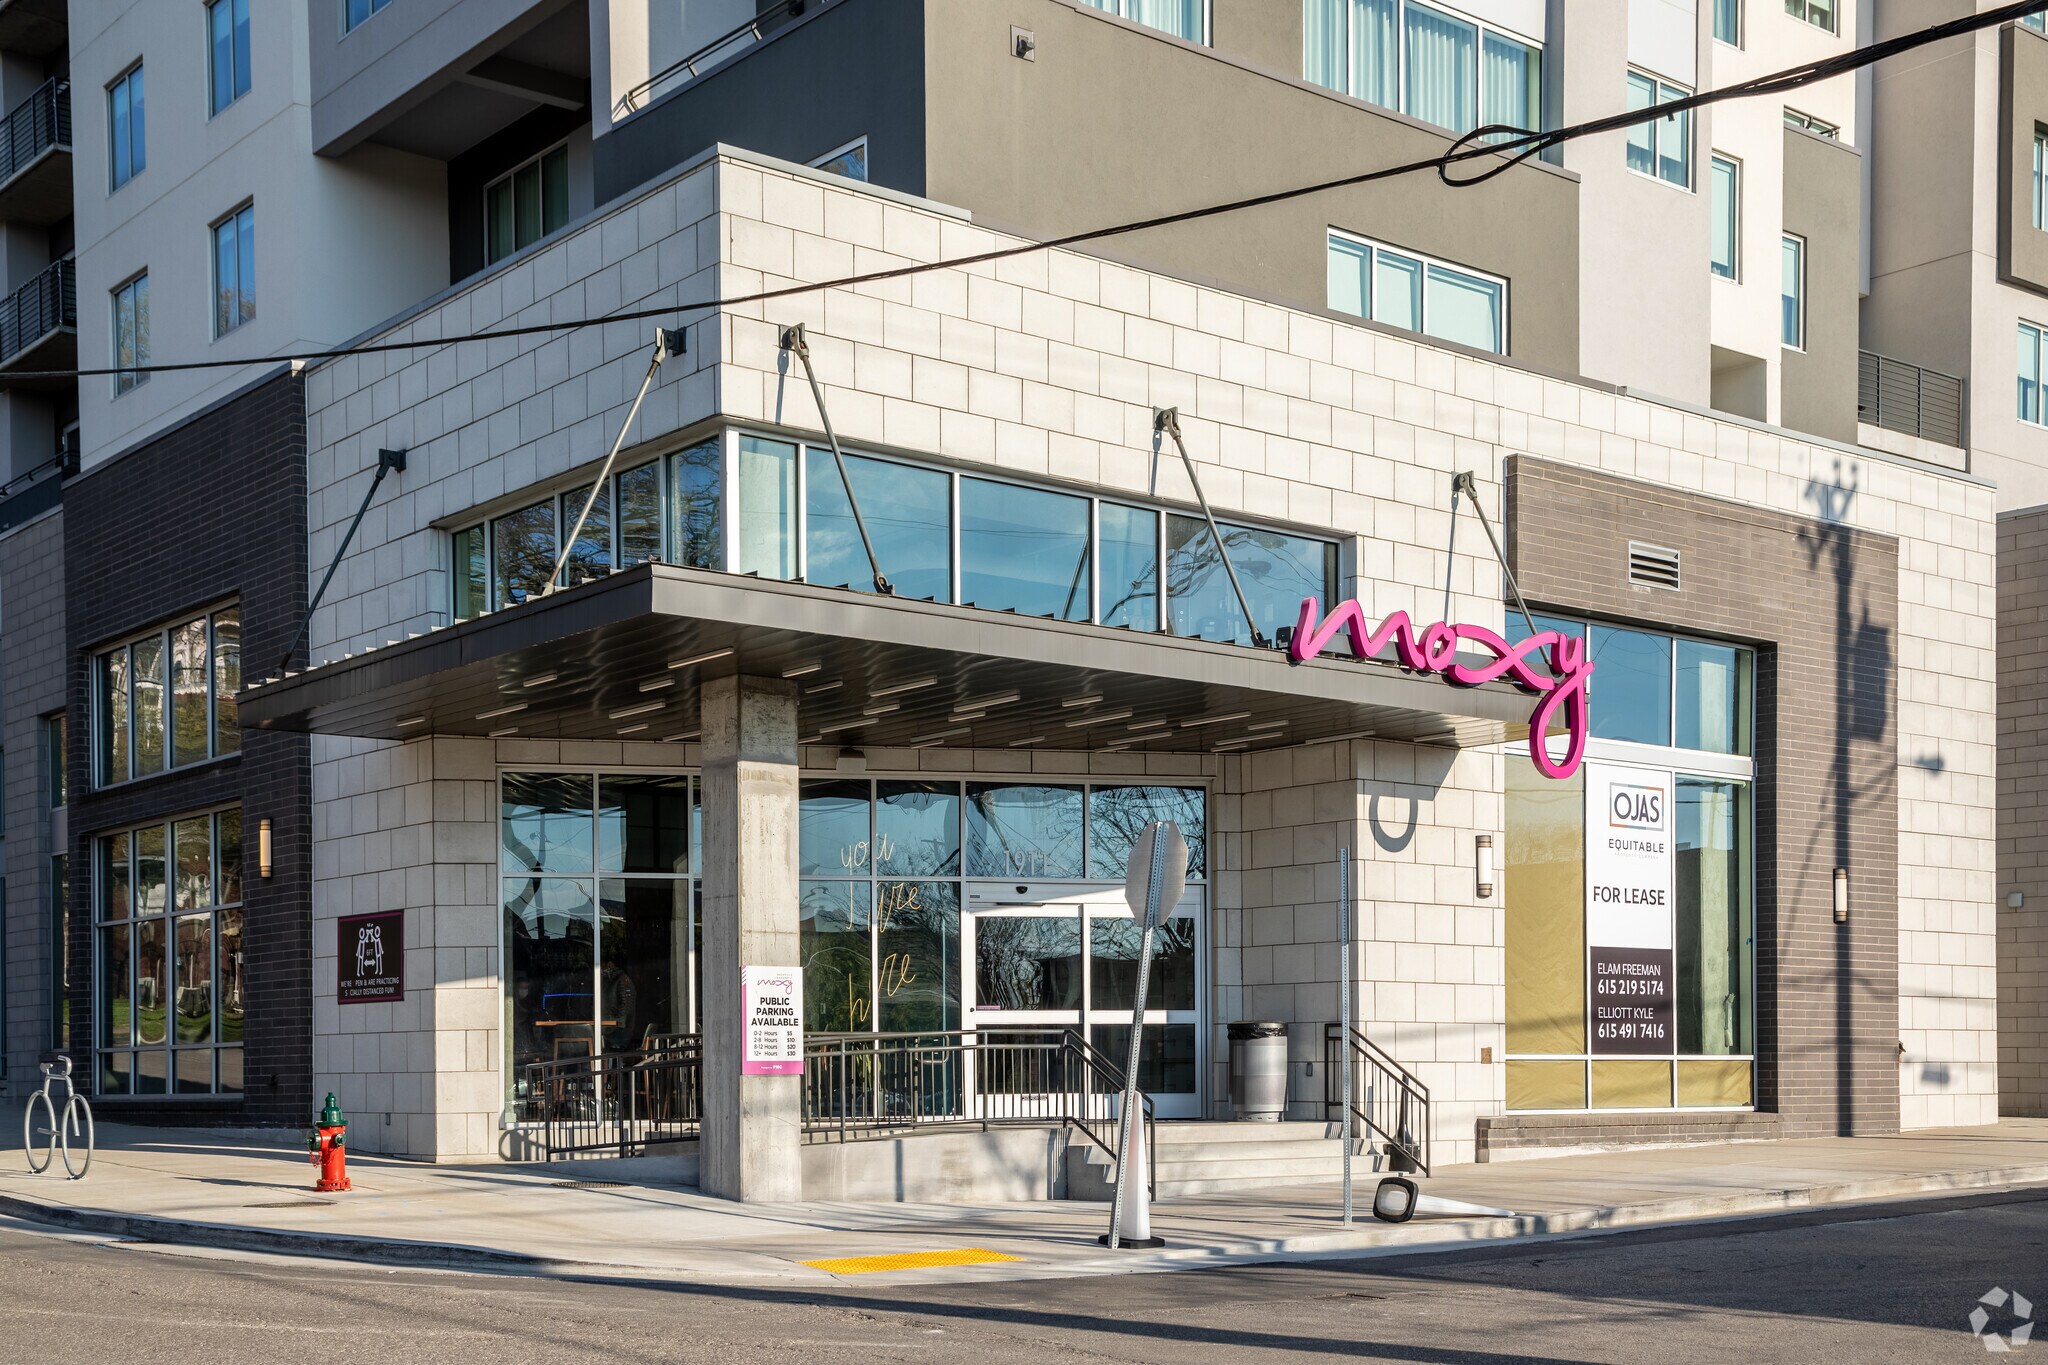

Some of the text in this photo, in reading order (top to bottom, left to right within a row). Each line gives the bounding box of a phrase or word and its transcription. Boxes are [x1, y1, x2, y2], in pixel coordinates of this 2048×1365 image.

[1291, 595, 1595, 779] moxy
[1614, 792, 1660, 823] OJAS
[1608, 838, 1665, 854] EQUITABLE
[1003, 849, 1049, 876] 1911
[841, 833, 894, 930] you
[1593, 886, 1666, 906] FOR LEASE
[1597, 963, 1661, 976] ELAM FREEMAN
[1597, 980, 1664, 995] 615 219 5174
[760, 997, 790, 1006] PUBLIC
[756, 1007, 794, 1016] PARKING
[1598, 1007, 1654, 1019] ELLIOTT KYLE
[751, 1017, 799, 1026] AVAILABLE
[1598, 1023, 1665, 1038] 615 491 7416
